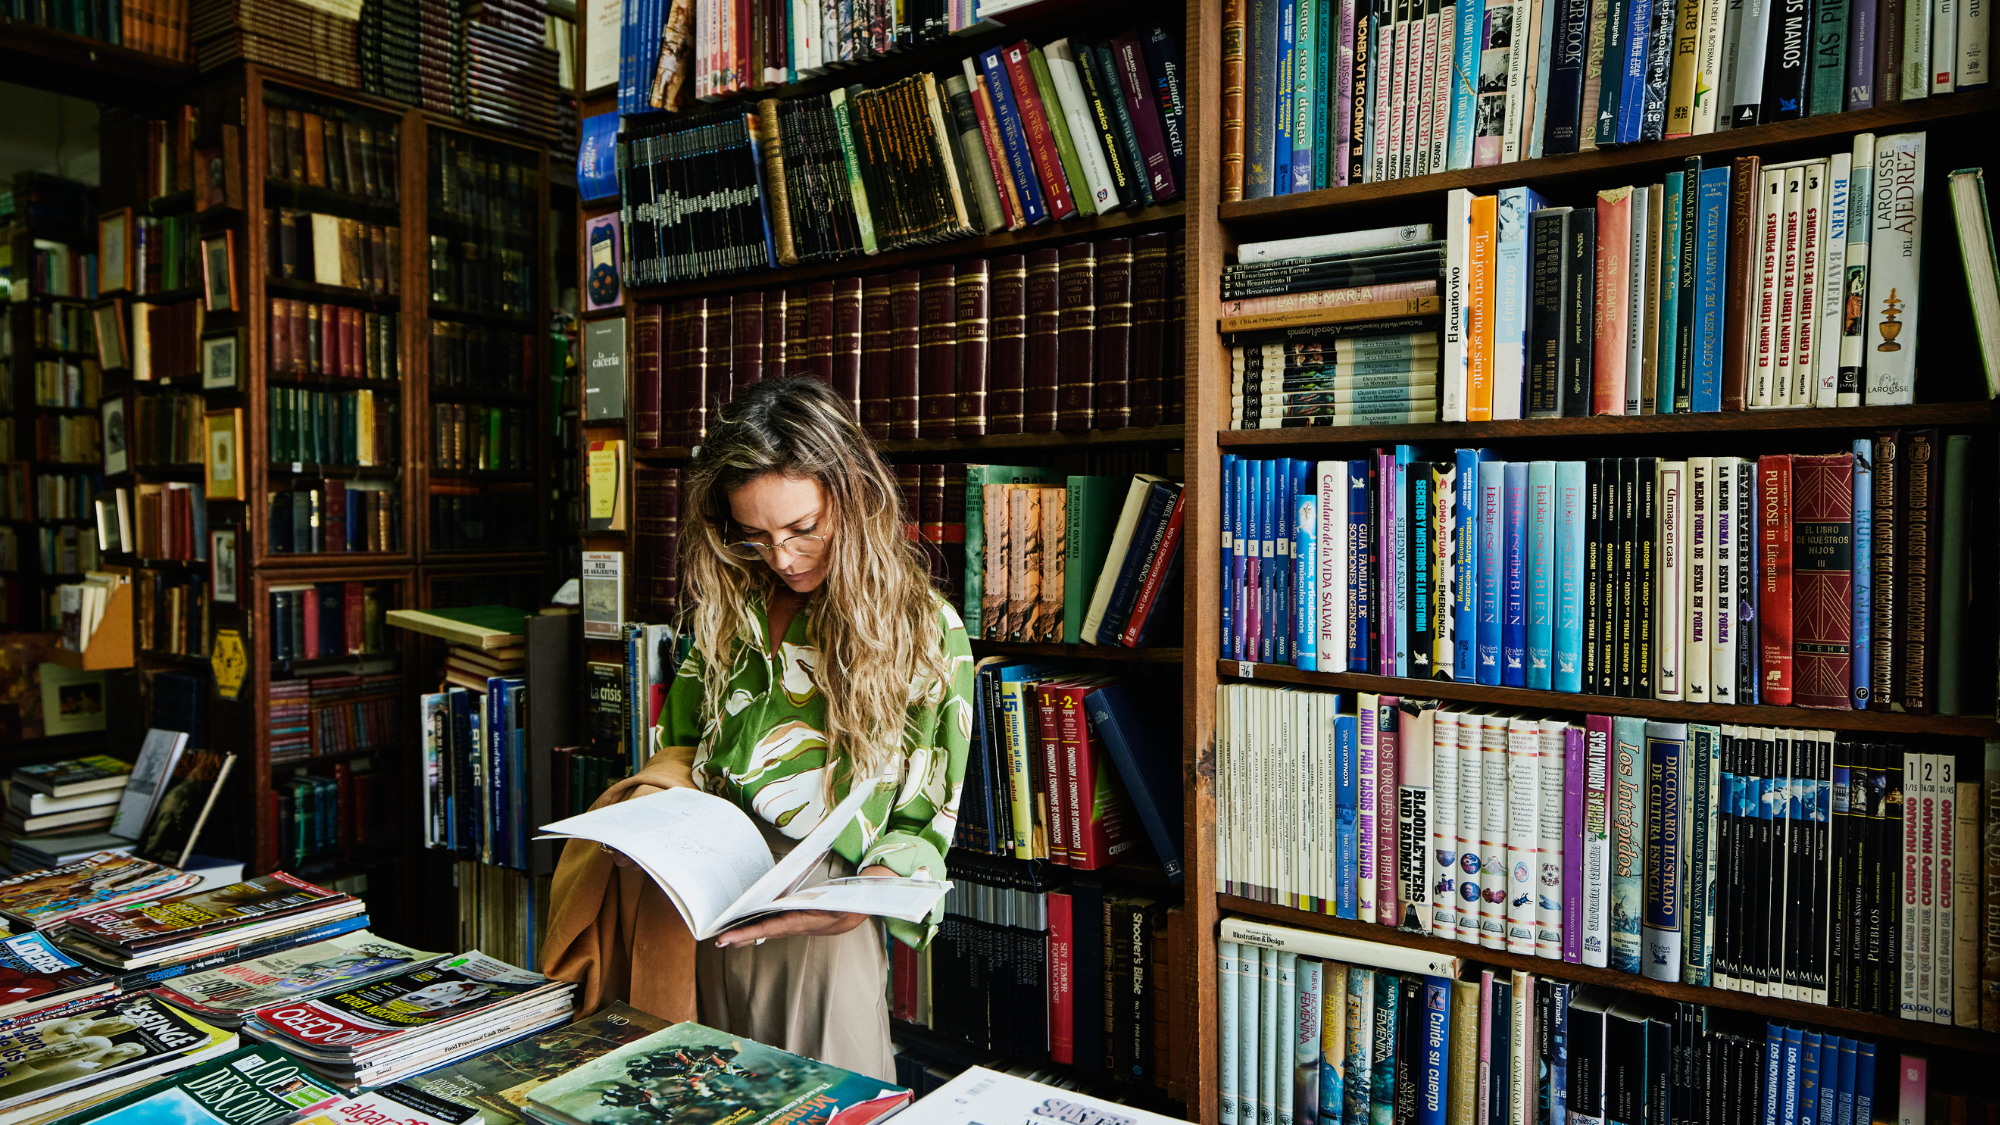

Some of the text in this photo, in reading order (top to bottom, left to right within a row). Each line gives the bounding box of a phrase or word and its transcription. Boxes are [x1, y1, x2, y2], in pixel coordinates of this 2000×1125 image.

[1441, 43, 1451, 53] DE
[1564, 21, 1583, 64] BOOK
[1782, 18, 1803, 69] MANOS
[1299, 49, 1307, 79] sexo
[1437, 55, 1451, 102] BIOGRAFIAS
[1164, 61, 1184, 115] diccionario
[1297, 84, 1306, 93] y
[1353, 15, 1368, 156] EL MUNDO DE LA CIENCIA
[999, 102, 1009, 115] DE
[1157, 78, 1183, 157] MULTILINGÜE
[1296, 98, 1308, 145] drogas
[1434, 103, 1446, 140] GRANDES
[1002, 117, 1017, 150] GENERAL
[1013, 152, 1028, 189] HISTORIA
[1104, 134, 1126, 187] desconocido
[1433, 141, 1442, 168] OCEANO
[1770, 182, 1778, 195] 1
[1790, 180, 1798, 192] 2
[1810, 177, 1818, 189] 3
[1877, 150, 1894, 230] LAROUSSE
[1894, 151, 1916, 257] DEL AJEDREZ
[1765, 213, 1777, 252] PADRES
[1825, 179, 1847, 317] BAYERN BAVIERA
[1764, 255, 1775, 274] LOS
[1764, 276, 1773, 289] DE
[1277, 296, 1295, 308] LA
[1448, 267, 1460, 343] El acuario vivo
[1472, 231, 1489, 389] Tan joven como se siente
[1760, 326, 1770, 353] GRAN
[1759, 355, 1769, 367] EL
[1439, 499, 1448, 523] CÓMO
[1485, 487, 1495, 525] Hablar
[1164, 541, 1170, 550] DE
[1166, 527, 1175, 540] ASIA
[1396, 518, 1405, 561] ÁNGELES
[1665, 489, 1676, 568] Un mago en casa
[1739, 471, 1749, 594] SOBRENATURAL
[1766, 470, 1778, 592] PURPOSE in Literature
[1796, 536, 1849, 544] DE NUESTROS
[1803, 525, 1839, 534] EL LIBRO
[1153, 551, 1166, 575] RELIGIONES
[1321, 474, 1333, 640] Calendario de la VIDA SALVAJE
[1349, 523, 1357, 585] SOLUCIONES
[1485, 532, 1495, 578] escribir
[1719, 466, 1728, 644] LA MEJOR FORMA DE ESTAR EN FORMA
[1817, 560, 1826, 568] III
[1142, 575, 1156, 602] GRANDES
[1358, 553, 1366, 601] FAMILIAR
[1397, 571, 1405, 610] SANTOS
[1358, 605, 1366, 618] DE
[1438, 584, 1446, 639] EMERGENCIA
[1485, 579, 1494, 623] BIEN
[590, 682, 621, 702] La crisis
[1002, 692, 1017, 712] 15
[1004, 714, 1012, 734] para
[1011, 714, 1019, 747] minutos
[1007, 751, 1016, 778] mejor
[1013, 749, 1020, 757] al
[1009, 779, 1017, 802] salud
[1360, 708, 1374, 879] AUXILIO PARA CASOS IMPREVISTOS
[1400, 788, 1411, 818] AND
[1614, 740, 1639, 878] Los Intrépidos
[1380, 737, 1394, 891] LOS PORQUÉS DE LA BIBLIA
[1400, 822, 1412, 882] BADMEN
[1413, 790, 1426, 903] BLOODLETTERS
[1648, 763, 1662, 904] DE CULTURA ESENCIAL
[1662, 755, 1677, 915] DICCIONARIO ILUSTRADO
[1940, 800, 1952, 908] CUERPO HUMANO
[1132, 912, 1144, 995] Shooter's Bible
[1233, 931, 1261, 942] Illustration
[1266, 937, 1285, 946] Design
[195, 960, 204, 968] No.
[205, 956, 225, 965] Volumen
[1059, 956, 1068, 993] TEMOR
[12, 1026, 47, 1050] Libro
[1375, 1007, 1387, 1063] FEMENINA
[1386, 985, 1395, 1057] NUEVA ENCICLOPEDIA
[1425, 1013, 1444, 1111] Cuide su cuerpo
